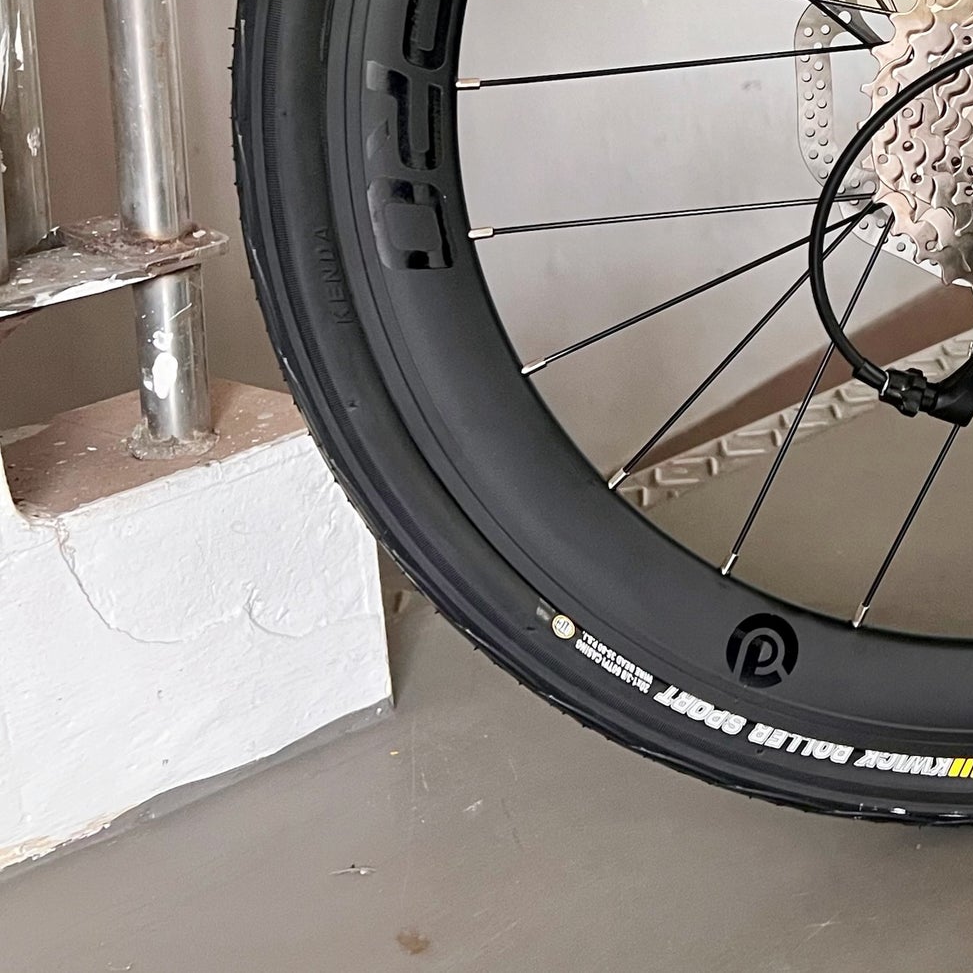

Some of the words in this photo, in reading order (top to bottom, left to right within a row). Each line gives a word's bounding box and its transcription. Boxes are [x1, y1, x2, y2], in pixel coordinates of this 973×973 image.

[314, 228, 356, 325] KENDA
[653, 684, 748, 735] SPORT
[747, 723, 855, 764] ROLLER
[854, 749, 952, 777] KWICK
